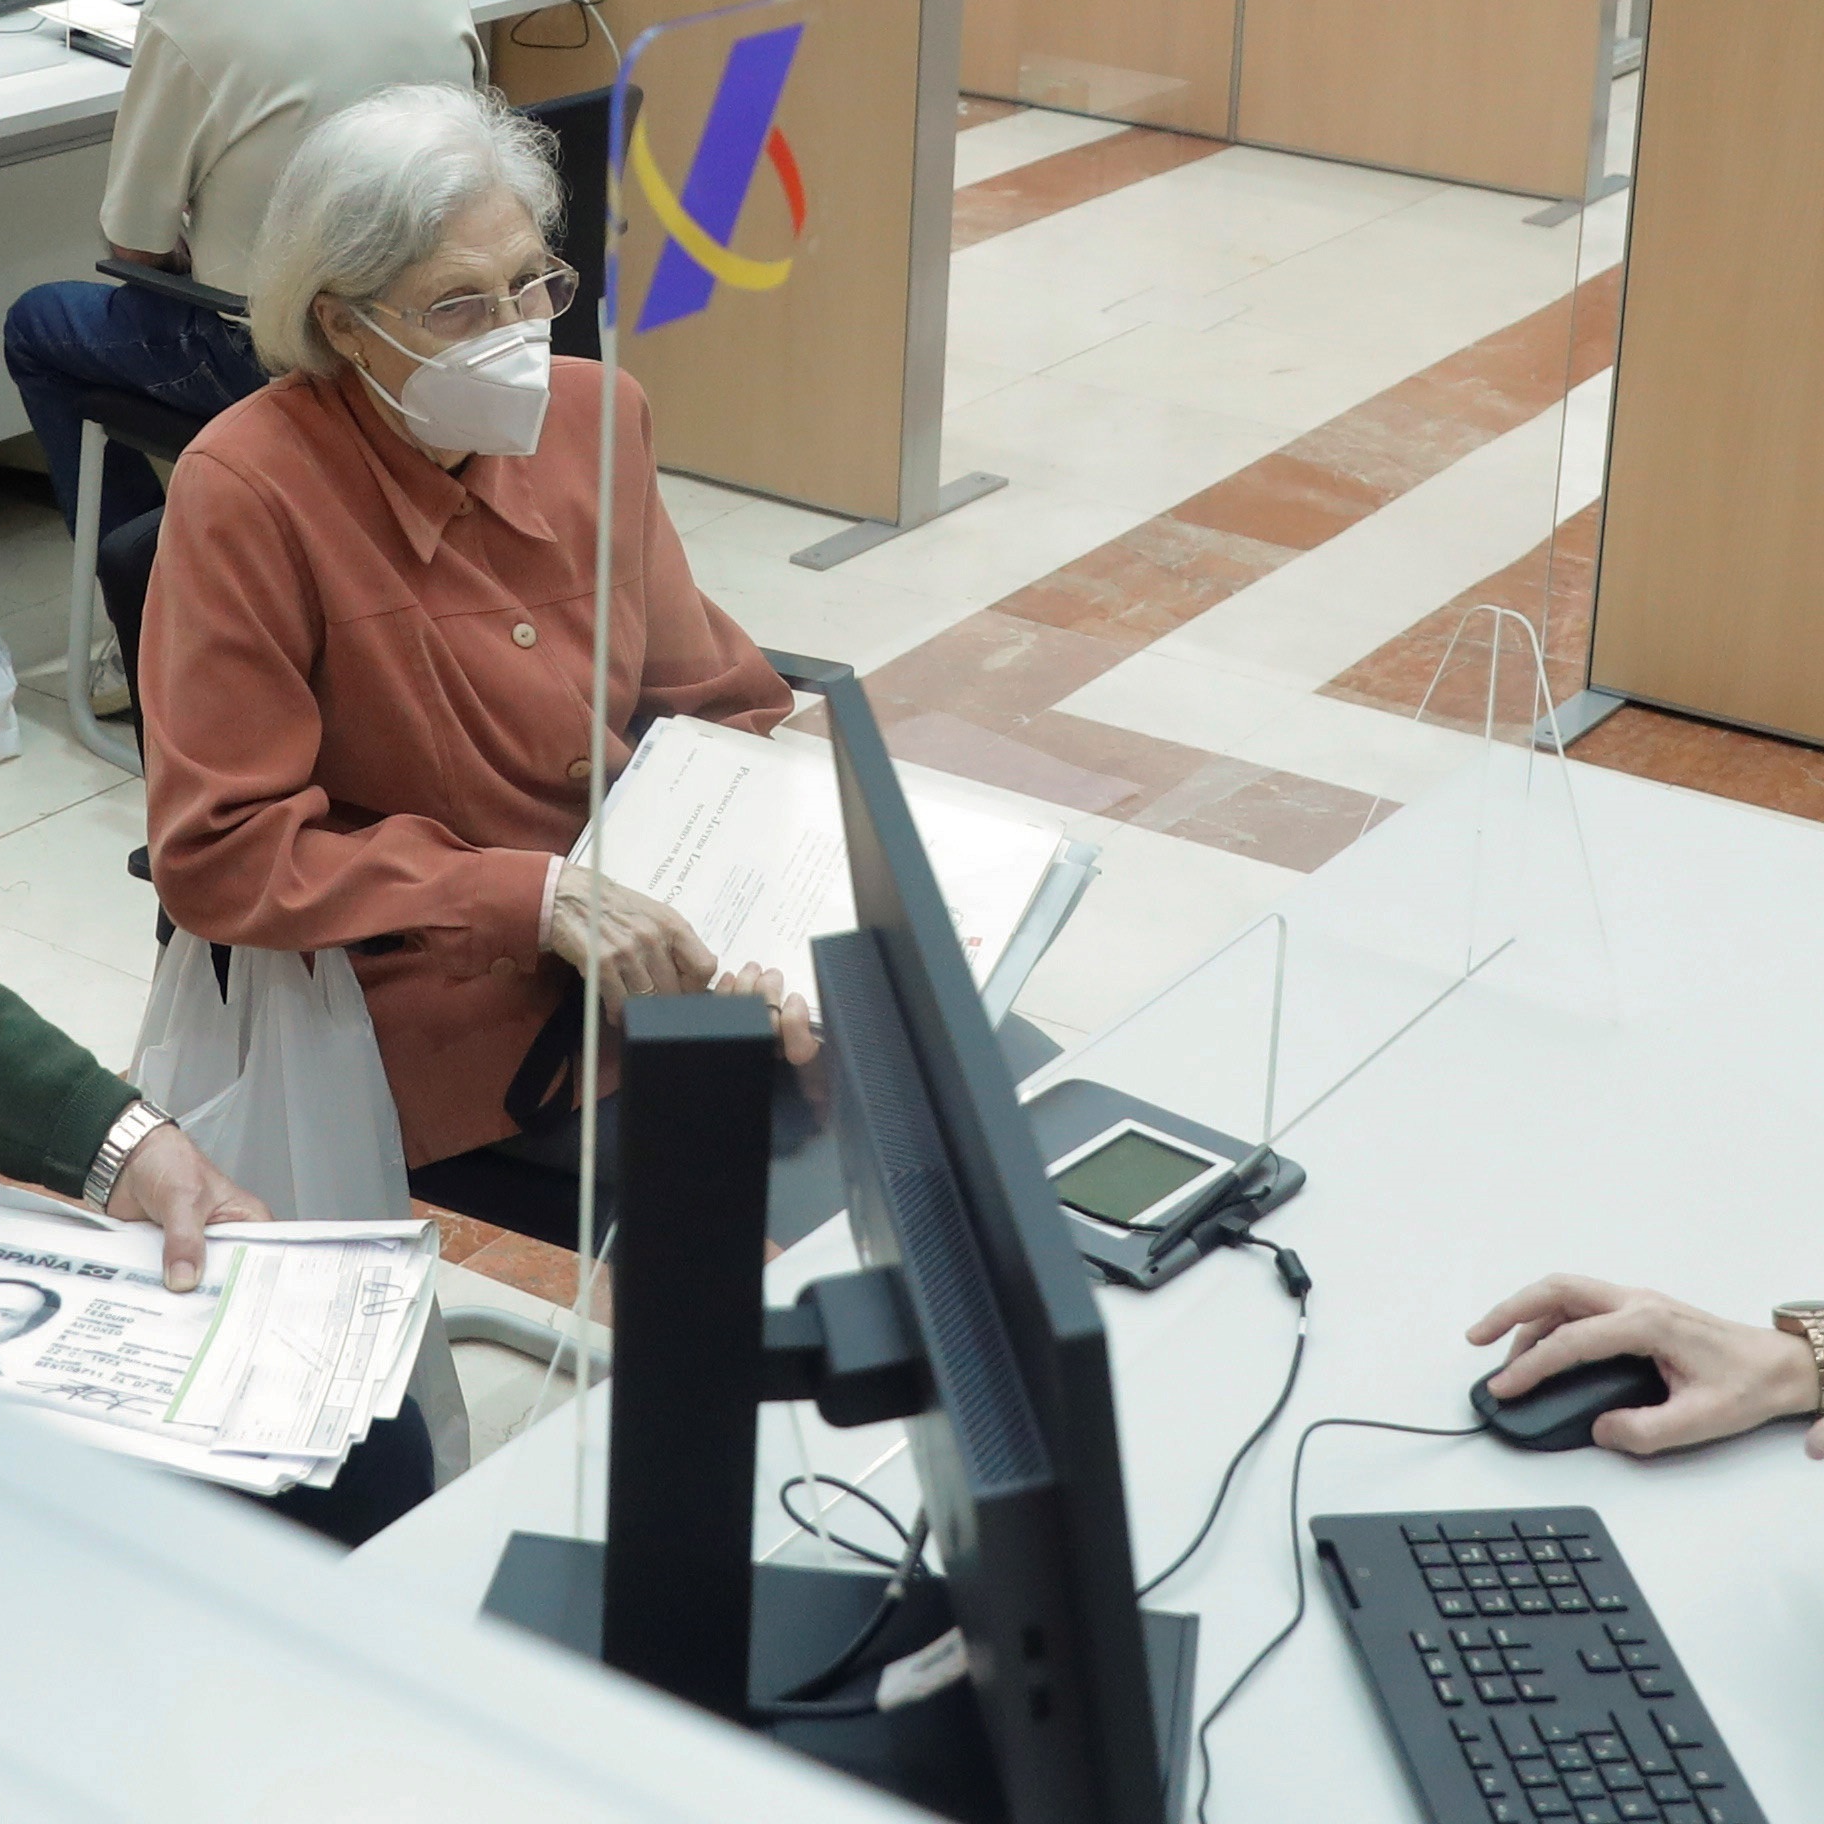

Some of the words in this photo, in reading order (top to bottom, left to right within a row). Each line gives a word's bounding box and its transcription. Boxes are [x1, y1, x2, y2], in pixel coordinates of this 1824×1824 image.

[648, 856, 672, 890] MADRID
[85, 1308, 135, 1324] TESOURO
[71, 1322, 123, 1336] ANTONIO
